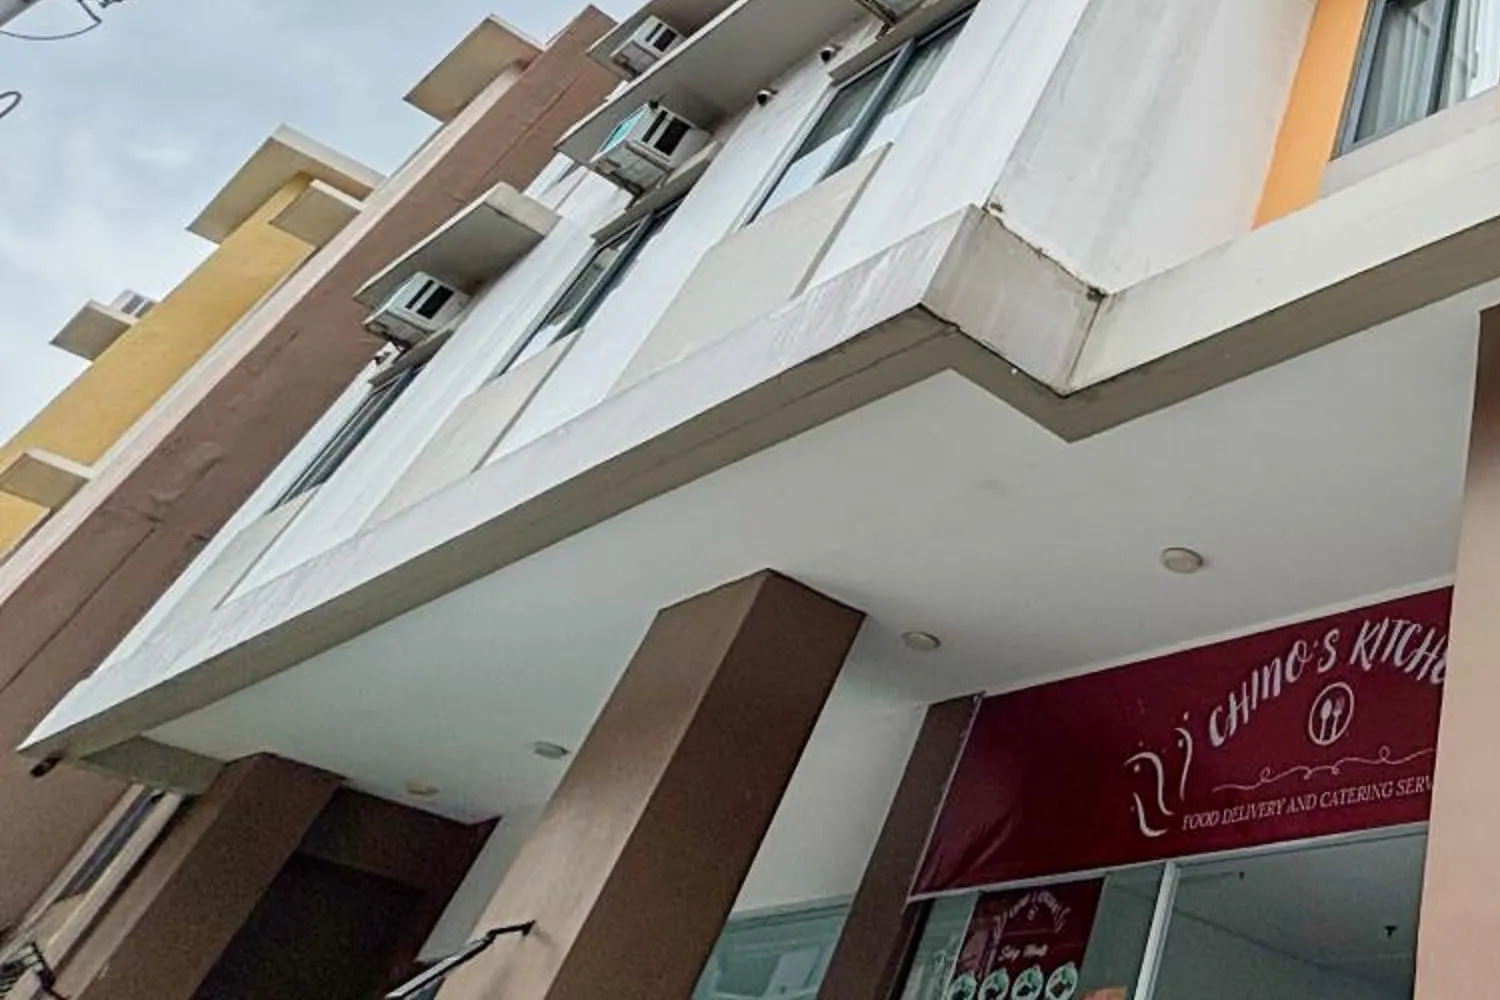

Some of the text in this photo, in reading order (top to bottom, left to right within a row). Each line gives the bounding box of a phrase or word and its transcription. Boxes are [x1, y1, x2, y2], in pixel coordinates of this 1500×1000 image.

[1208, 628, 1341, 748] CHINO'S
[1182, 810, 1220, 831] FOOD
[1221, 797, 1287, 825] DELIVERY
[1286, 792, 1318, 814] AND
[1319, 781, 1394, 808] CATERING
